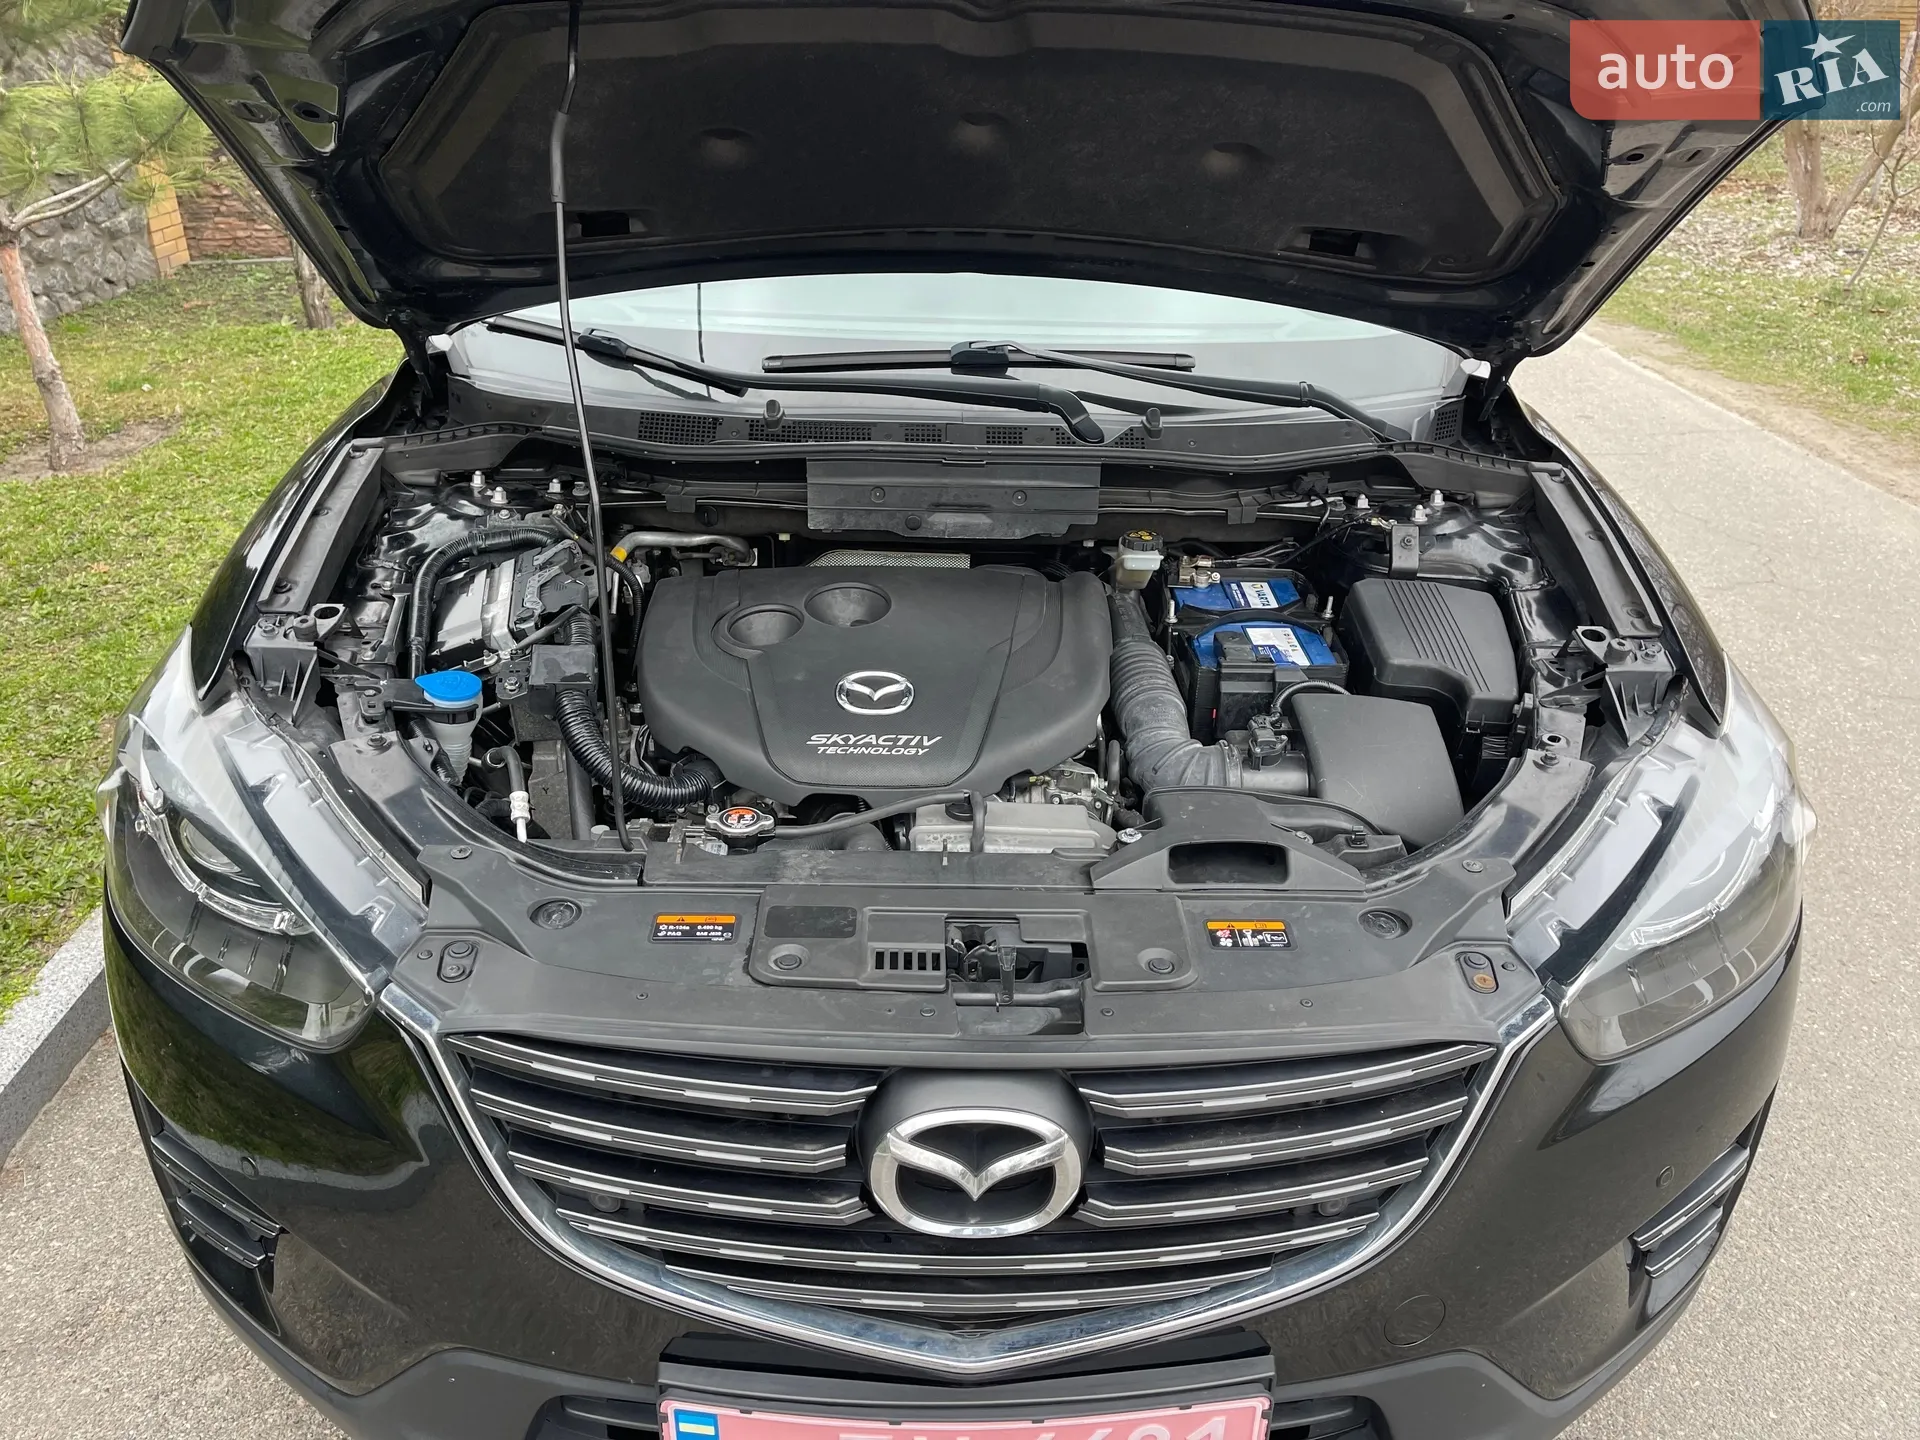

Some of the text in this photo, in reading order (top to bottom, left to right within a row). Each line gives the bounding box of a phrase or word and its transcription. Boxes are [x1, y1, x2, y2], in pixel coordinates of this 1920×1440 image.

[1255, 589, 1271, 606] VARTA
[806, 733, 943, 746] SKYACTIV
[817, 746, 930, 756] TECHNOLOGY
